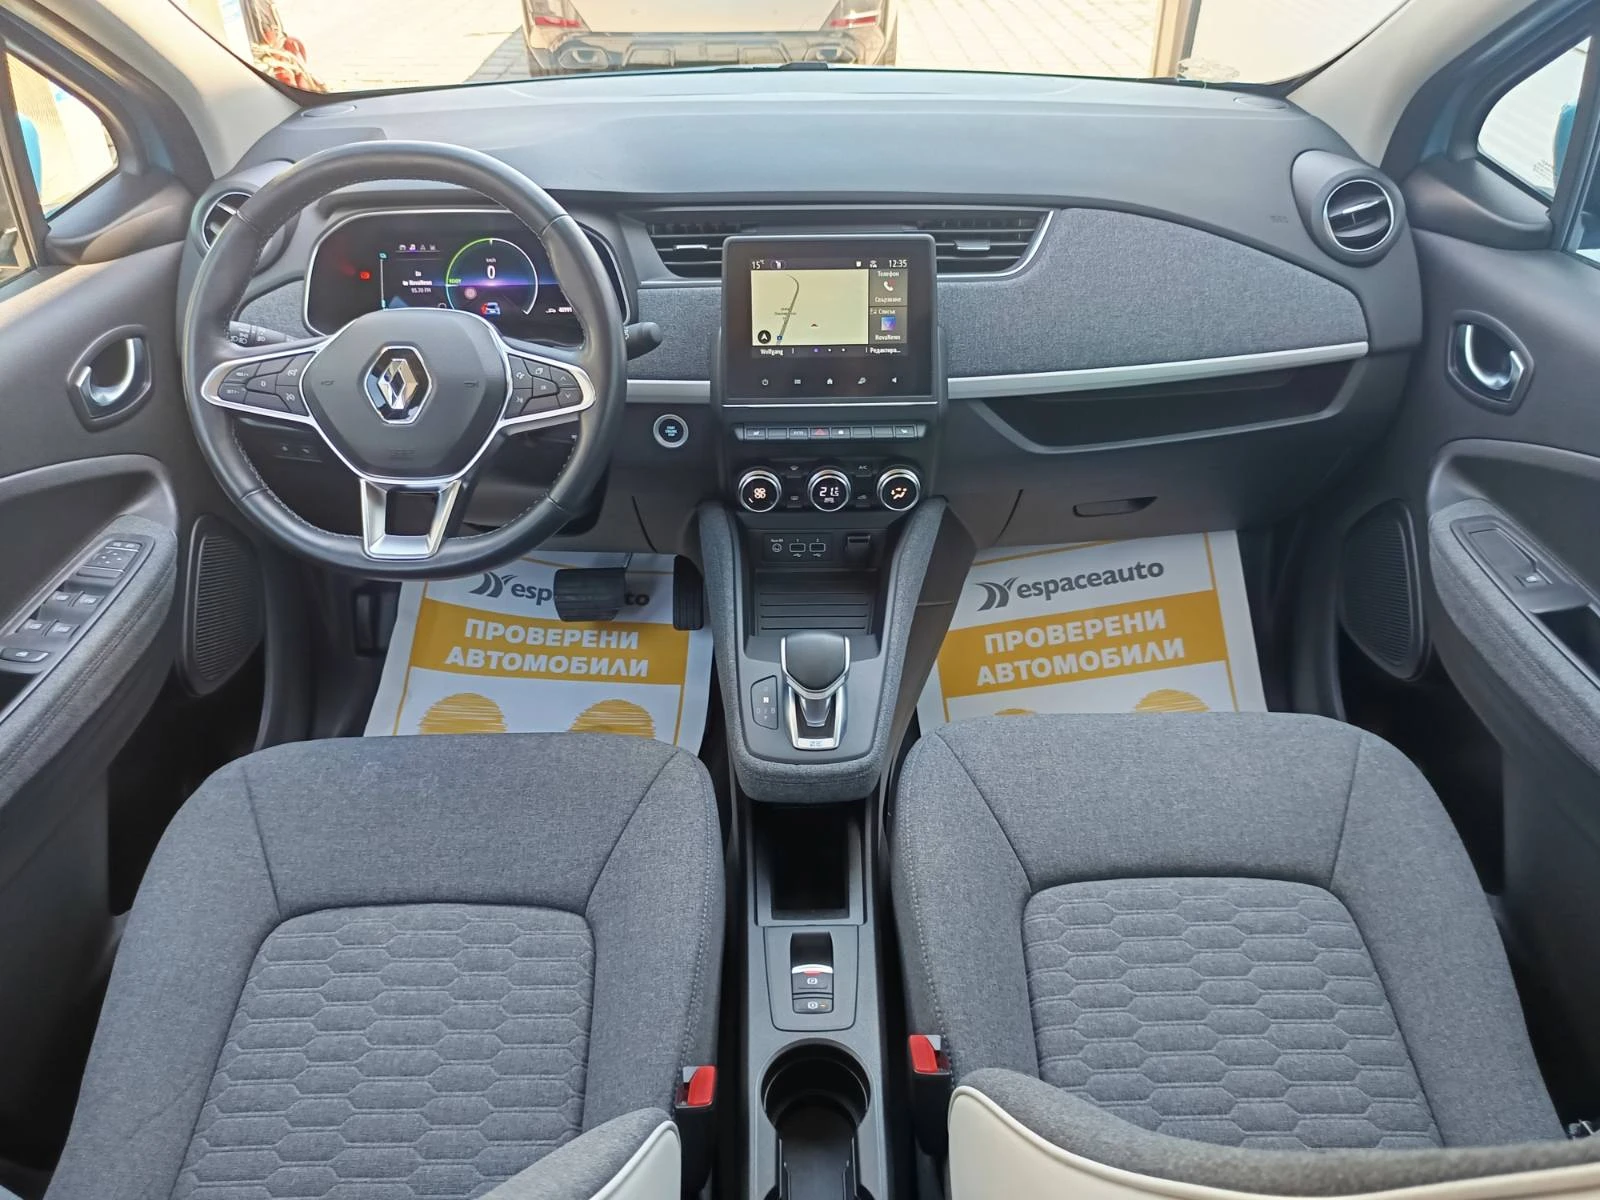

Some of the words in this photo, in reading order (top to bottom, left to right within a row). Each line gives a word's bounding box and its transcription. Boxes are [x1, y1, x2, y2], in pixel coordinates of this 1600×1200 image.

[487, 264, 496, 280] 0
[888, 259, 908, 268] 12:35
[1016, 560, 1165, 601] espaceauto
[464, 618, 640, 650] ПРОВЕРЕНИ
[983, 608, 1168, 655] ПРОВЕРЕНИ
[445, 646, 649, 677] АВТОМОБИЛИ
[976, 637, 1186, 687] АВТОМОБИЛИ
